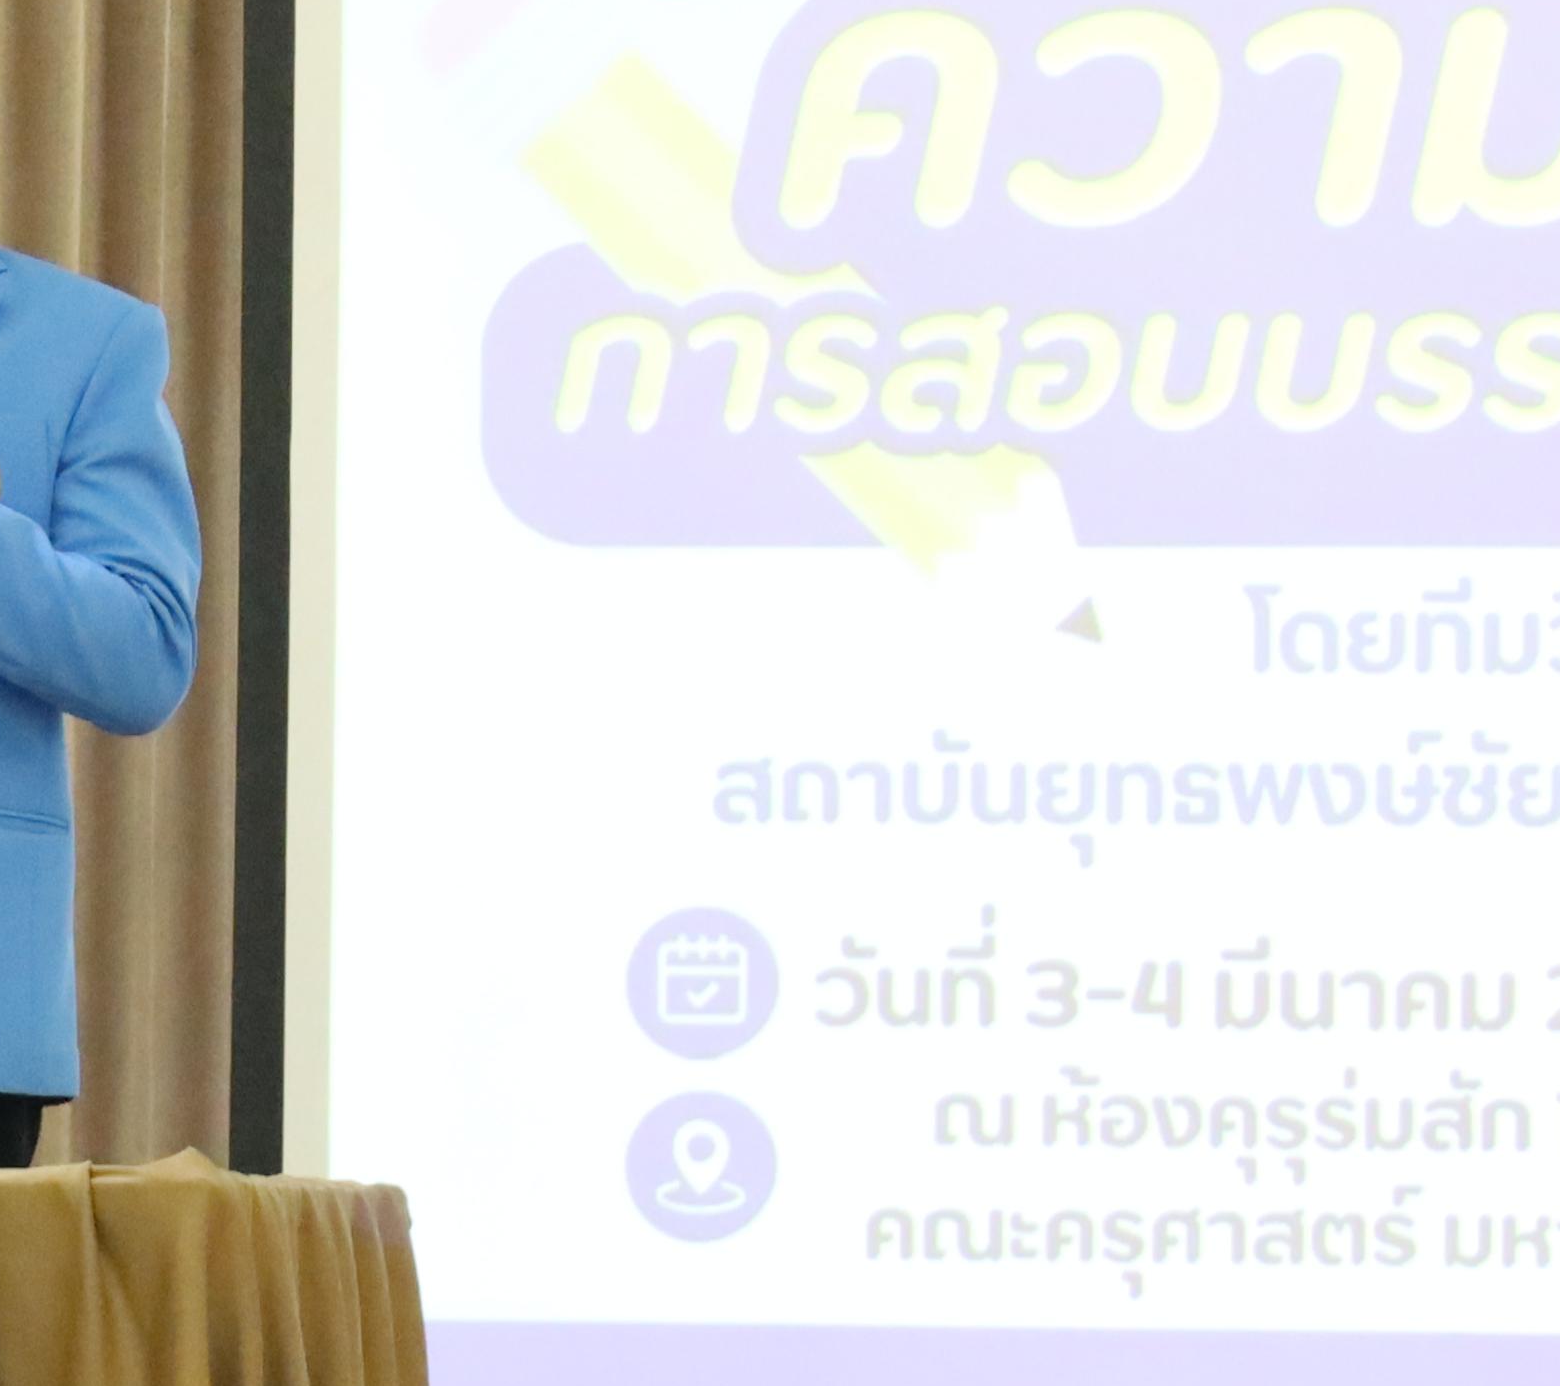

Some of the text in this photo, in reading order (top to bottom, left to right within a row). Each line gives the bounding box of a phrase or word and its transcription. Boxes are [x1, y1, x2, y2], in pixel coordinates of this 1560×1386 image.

[816, 903, 996, 1028] วันที่
[1215, 935, 1516, 1032] มีนาคม
[935, 1093, 1015, 1147] ณ
[1043, 1066, 1531, 1185] ห้องคุรุร่มสัก
[867, 1185, 1423, 1300] คณะครุศาสตร์
